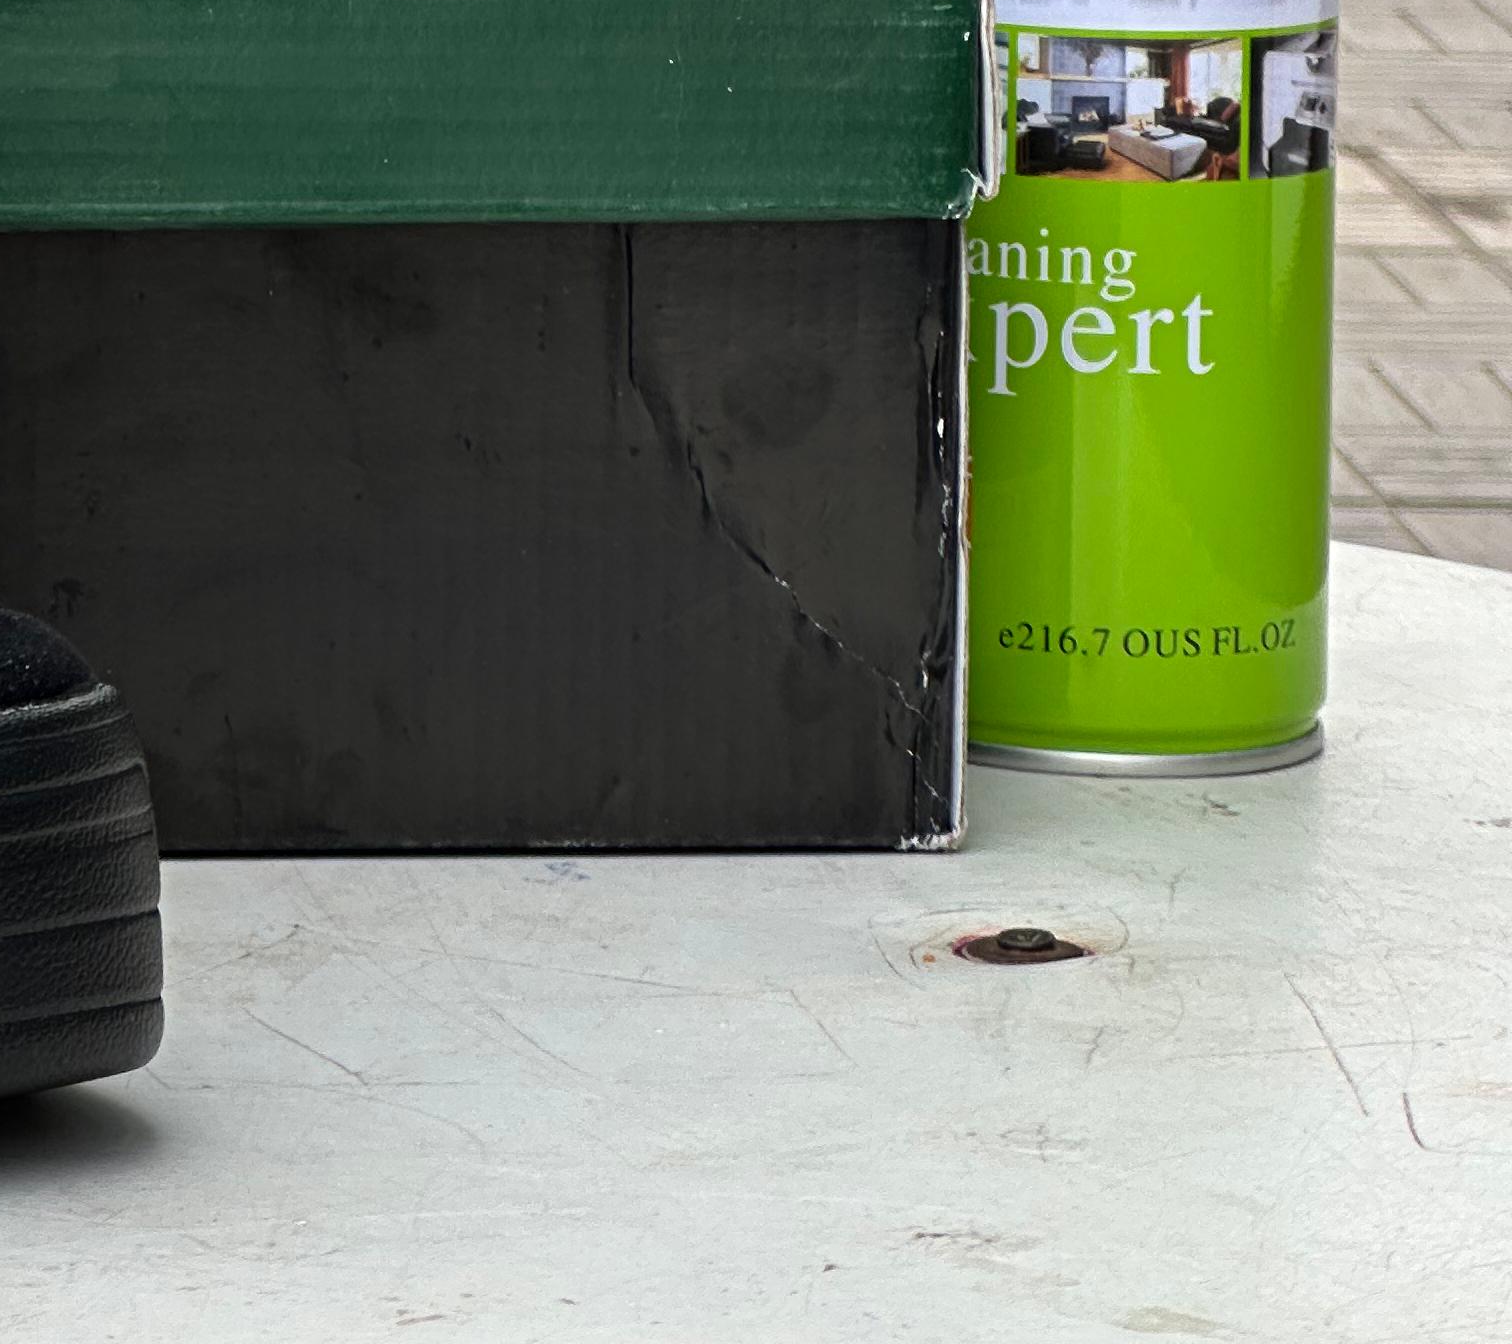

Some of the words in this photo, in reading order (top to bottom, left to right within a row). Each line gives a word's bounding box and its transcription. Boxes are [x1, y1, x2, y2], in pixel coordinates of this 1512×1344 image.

[969, 293, 1216, 396] pert
[998, 621, 1111, 657] e216.7
[1122, 628, 1202, 658] OUS
